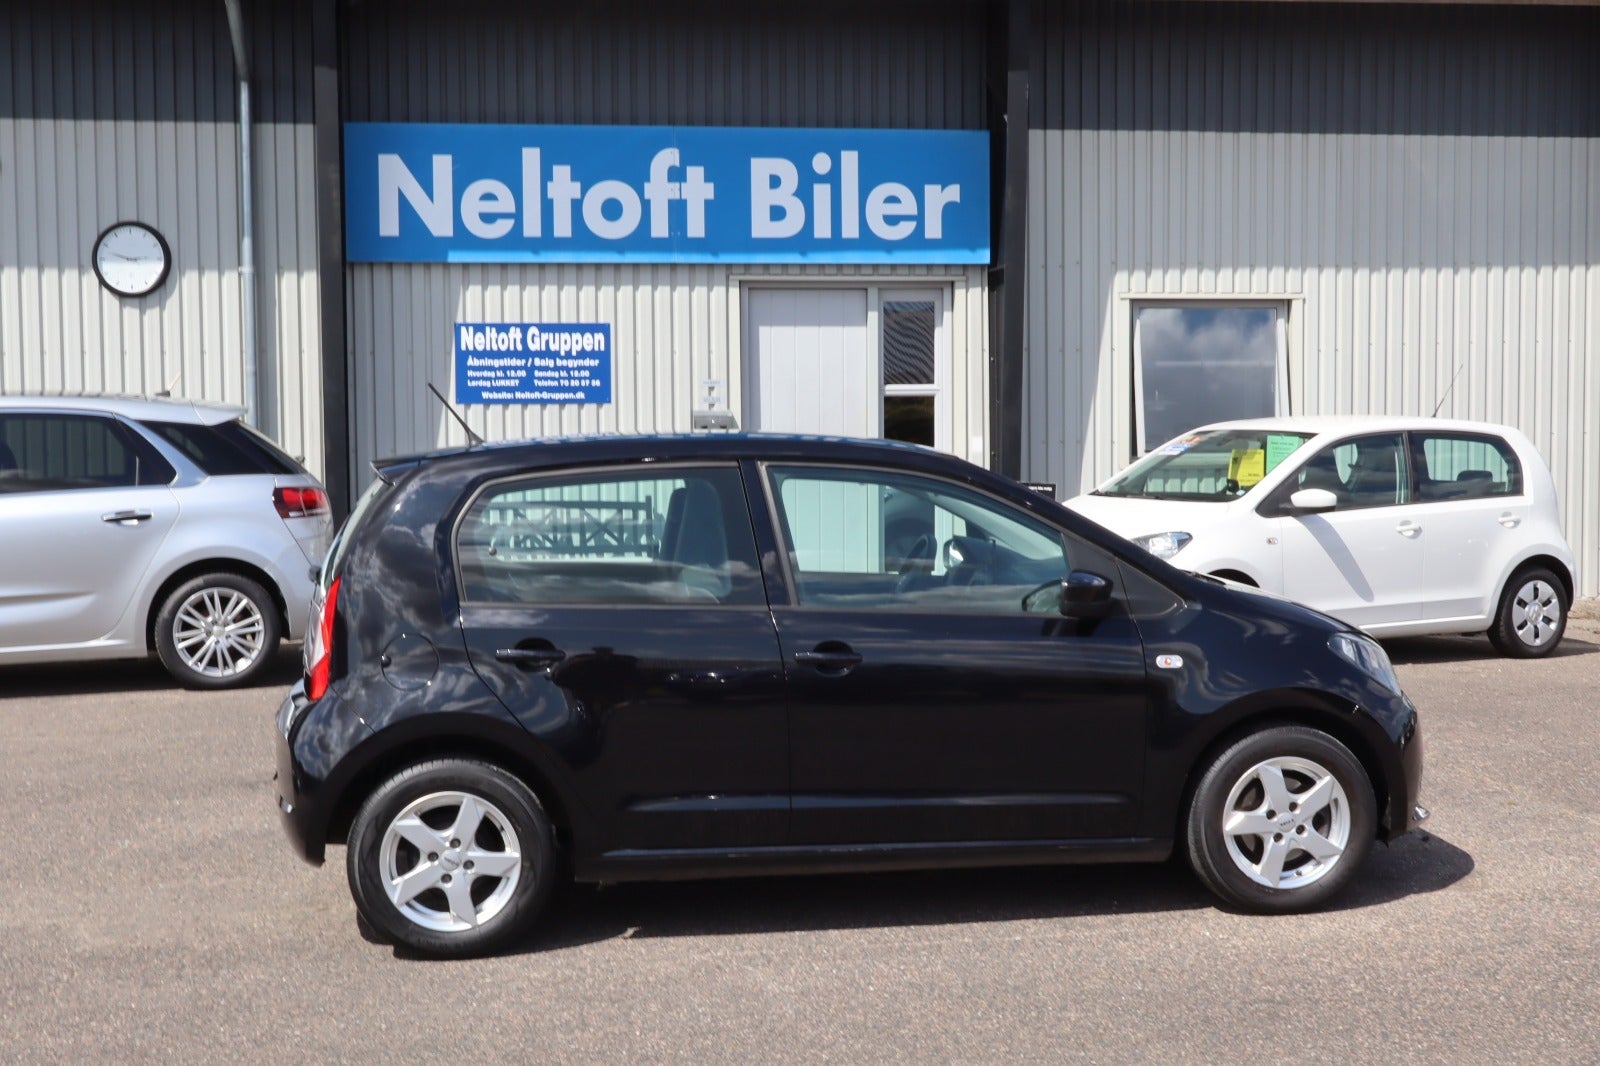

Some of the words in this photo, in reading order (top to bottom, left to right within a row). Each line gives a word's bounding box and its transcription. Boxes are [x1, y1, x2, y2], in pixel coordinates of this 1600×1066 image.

[377, 146, 715, 240] Neltoft
[750, 149, 962, 241] Biler
[460, 325, 523, 351] Neltoft
[526, 325, 605, 356] Gruppen
[466, 355, 526, 368] Åbningstider
[527, 357, 532, 367] /
[533, 357, 554, 368] Salg
[556, 357, 600, 368] begynder
[467, 369, 496, 378] Hverdag
[491, 379, 520, 387] LUKKET
[533, 379, 559, 387] Telefon
[481, 391, 514, 400] Website:
[515, 391, 586, 400] Neltoft-Gruppen.dk
